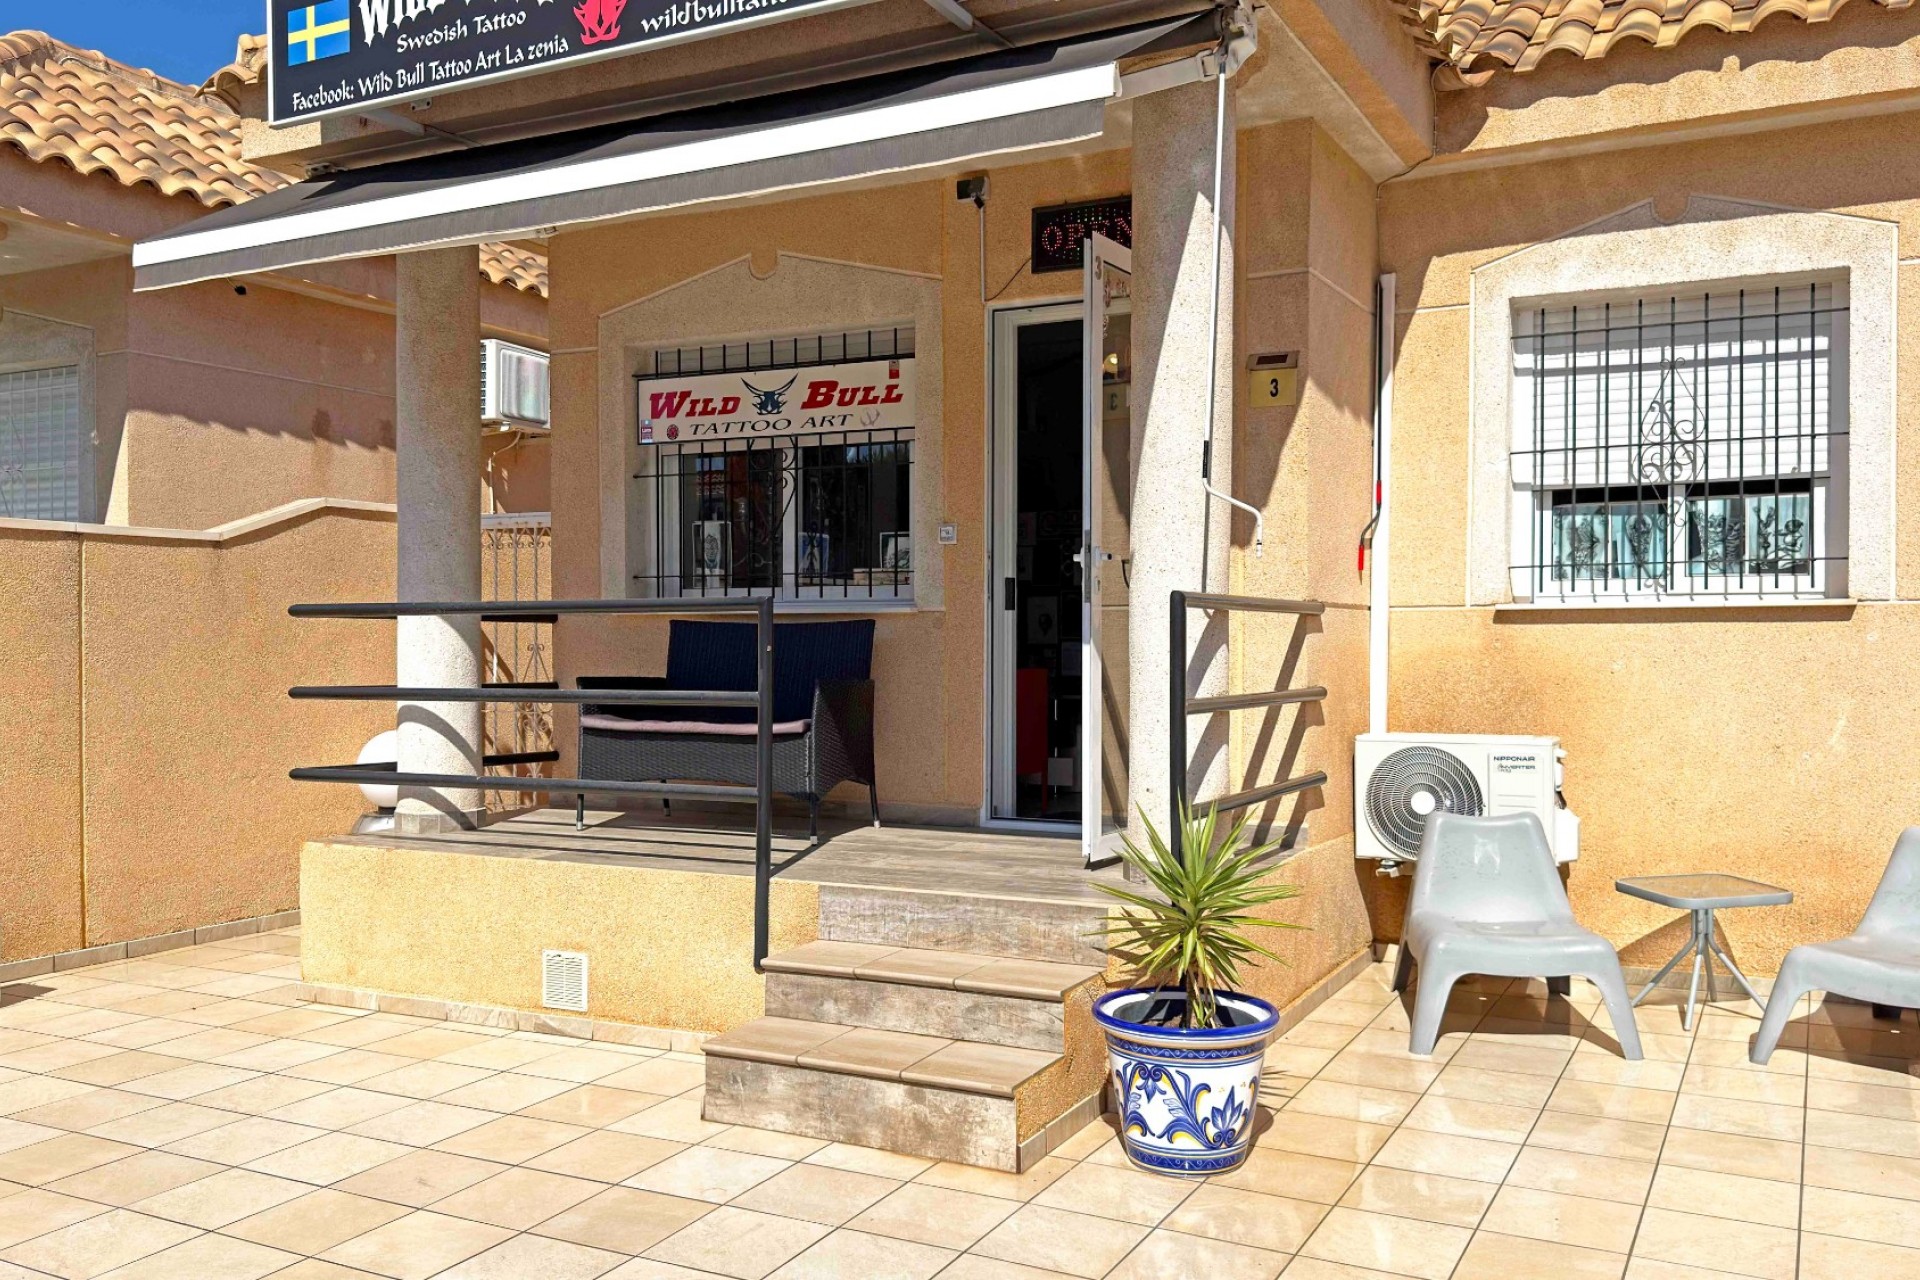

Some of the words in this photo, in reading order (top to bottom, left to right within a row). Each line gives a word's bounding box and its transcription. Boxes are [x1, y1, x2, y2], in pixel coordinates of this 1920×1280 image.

[396, 18, 468, 53] Swedish
[472, 10, 527, 35] Tattoo
[292, 79, 354, 112] Facebook:
[357, 70, 393, 97] Wild
[395, 61, 425, 89] Bull
[428, 59, 472, 81] Tattoo
[474, 50, 501, 72] Art
[505, 44, 524, 65] La
[528, 34, 569, 60] zenia
[1269, 378, 1279, 398] 3
[689, 418, 792, 436] TATTOO
[801, 413, 854, 429] ART
